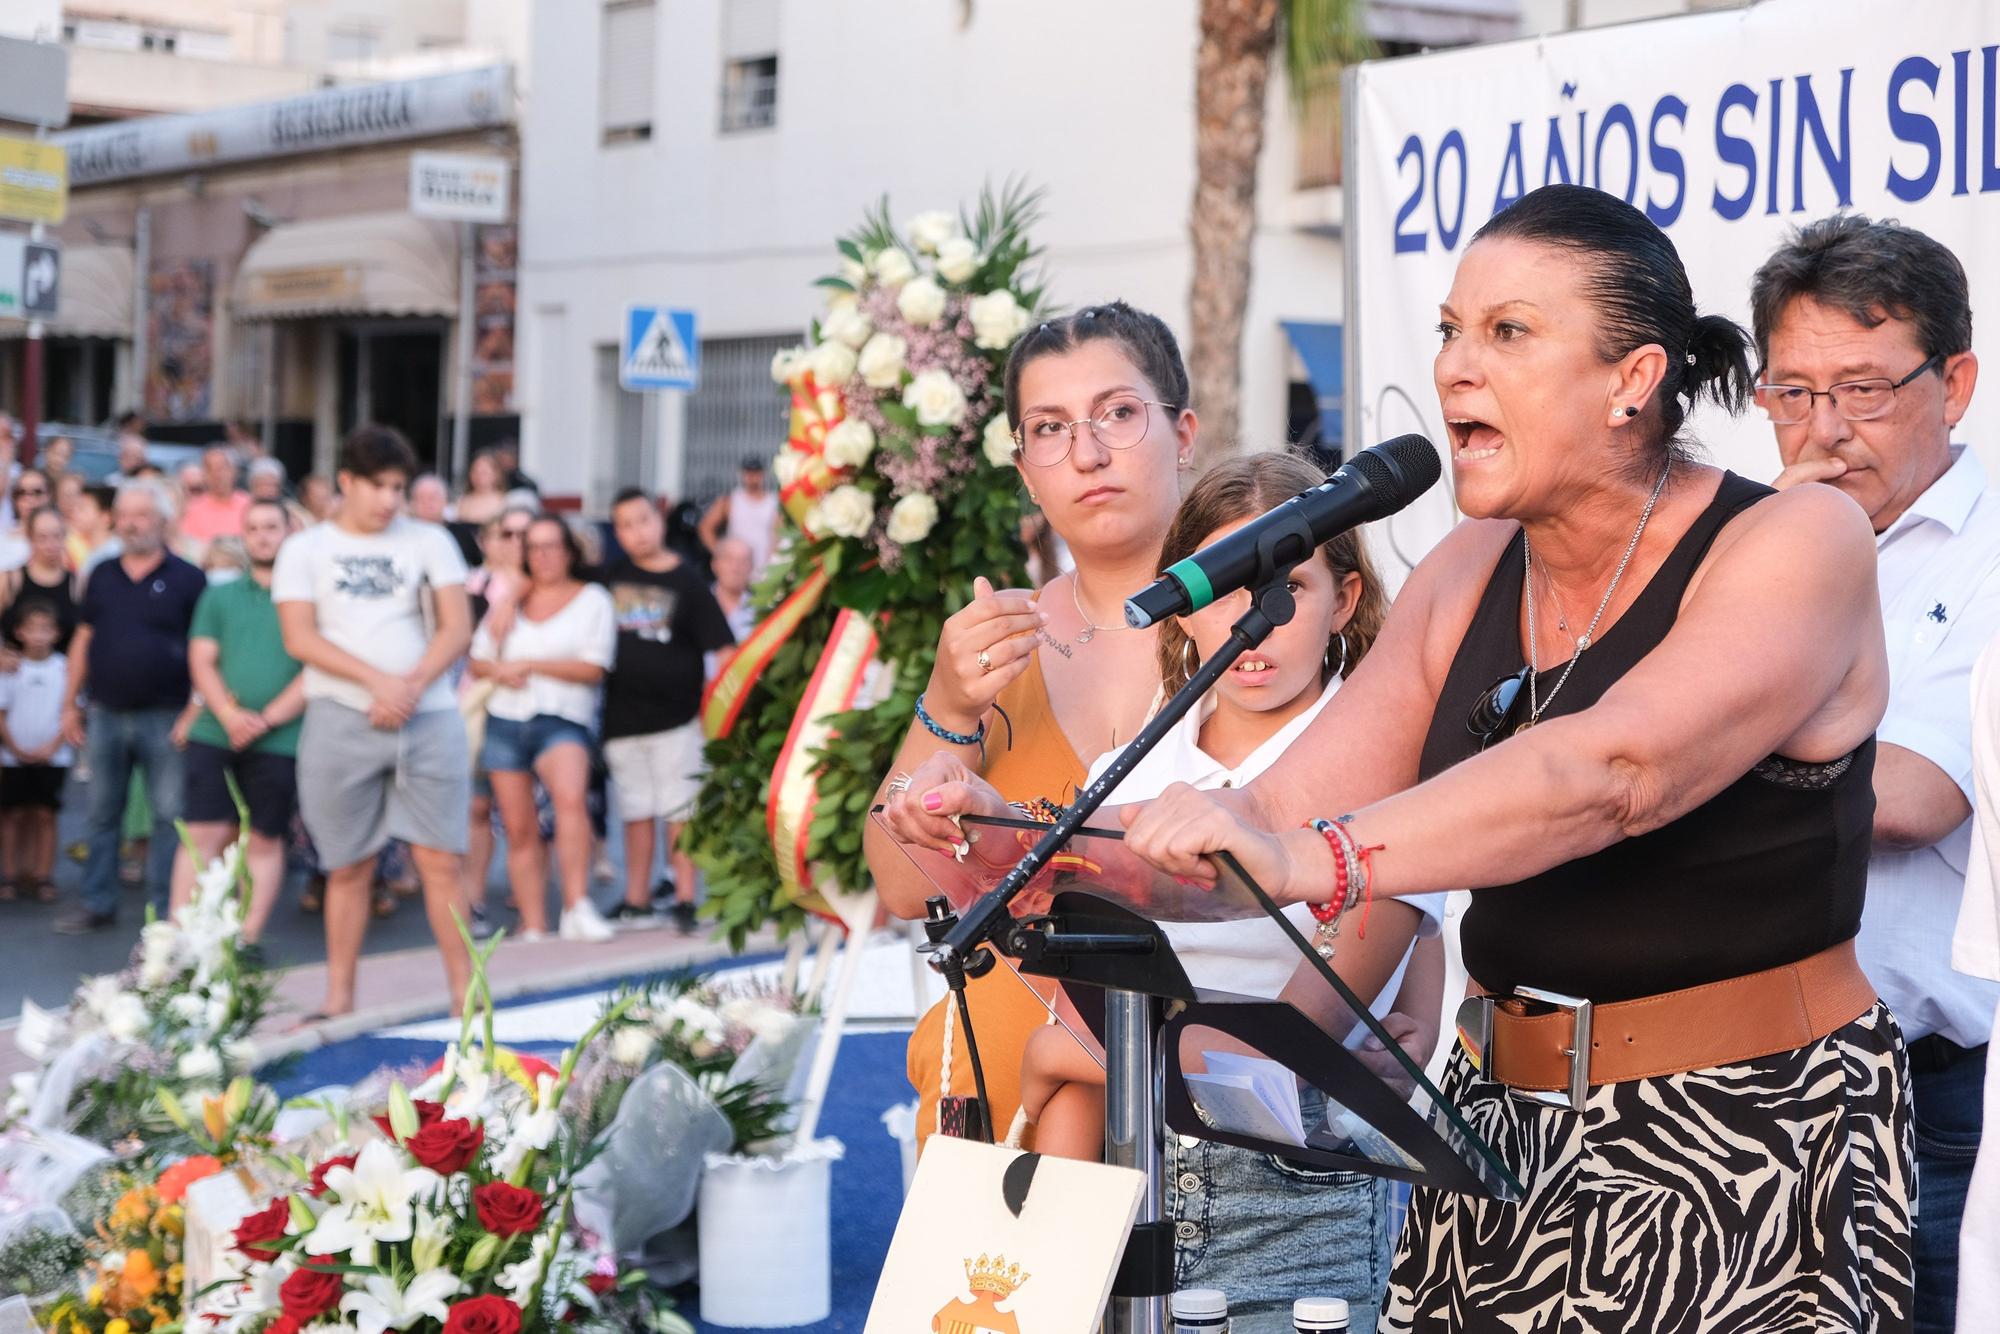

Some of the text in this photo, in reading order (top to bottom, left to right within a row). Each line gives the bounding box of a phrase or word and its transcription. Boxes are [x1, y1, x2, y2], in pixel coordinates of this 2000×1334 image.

[1395, 129, 1468, 254] 20
[1489, 80, 1688, 229] AÑOS
[1712, 67, 1855, 221] SIN
